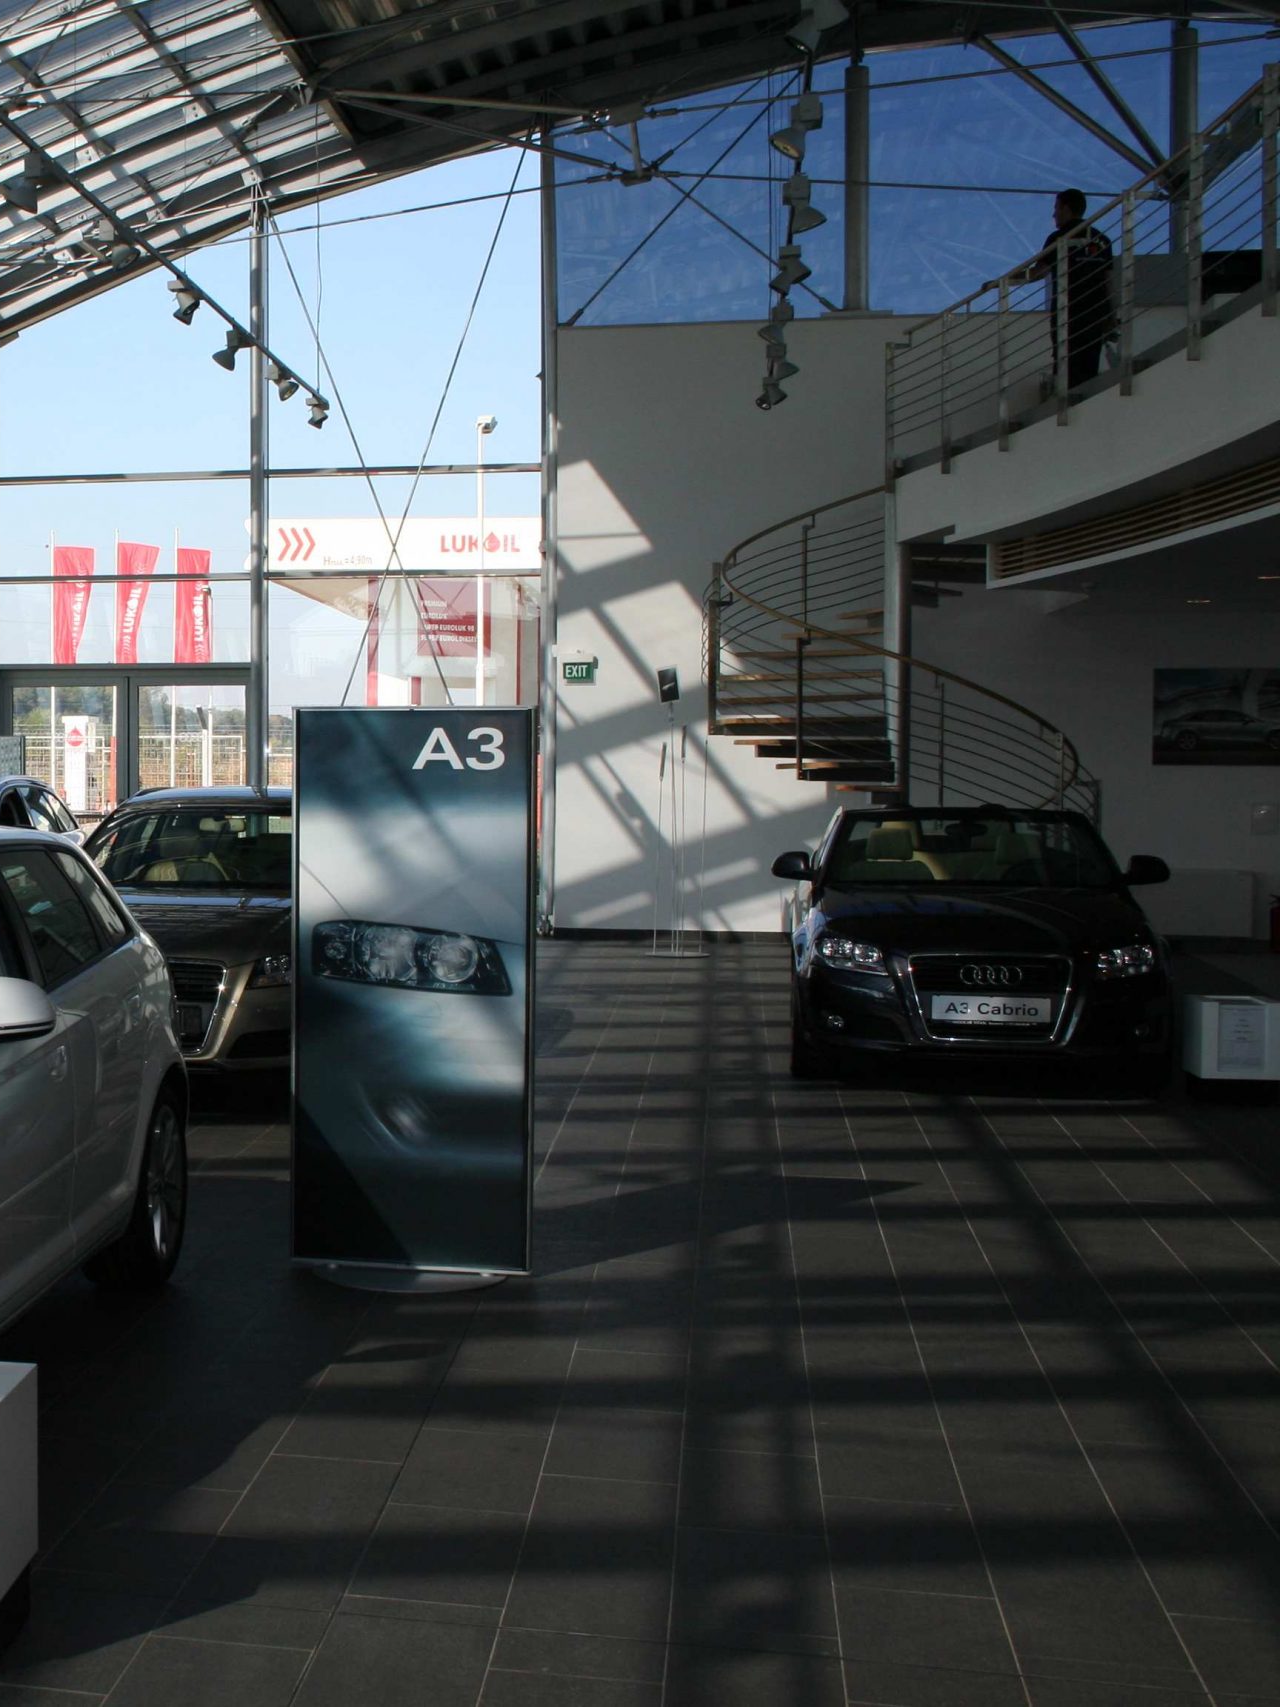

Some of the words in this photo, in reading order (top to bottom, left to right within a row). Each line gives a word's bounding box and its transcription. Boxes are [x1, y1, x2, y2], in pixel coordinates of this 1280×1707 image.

[440, 531, 520, 553] LUKOIL
[123, 587, 142, 632] LUKOIL
[192, 592, 205, 641] LUKOIL
[565, 664, 588, 678] EXIT
[412, 727, 505, 771] A3
[945, 1002, 969, 1014] A3
[977, 1002, 1039, 1017] Cabrio
